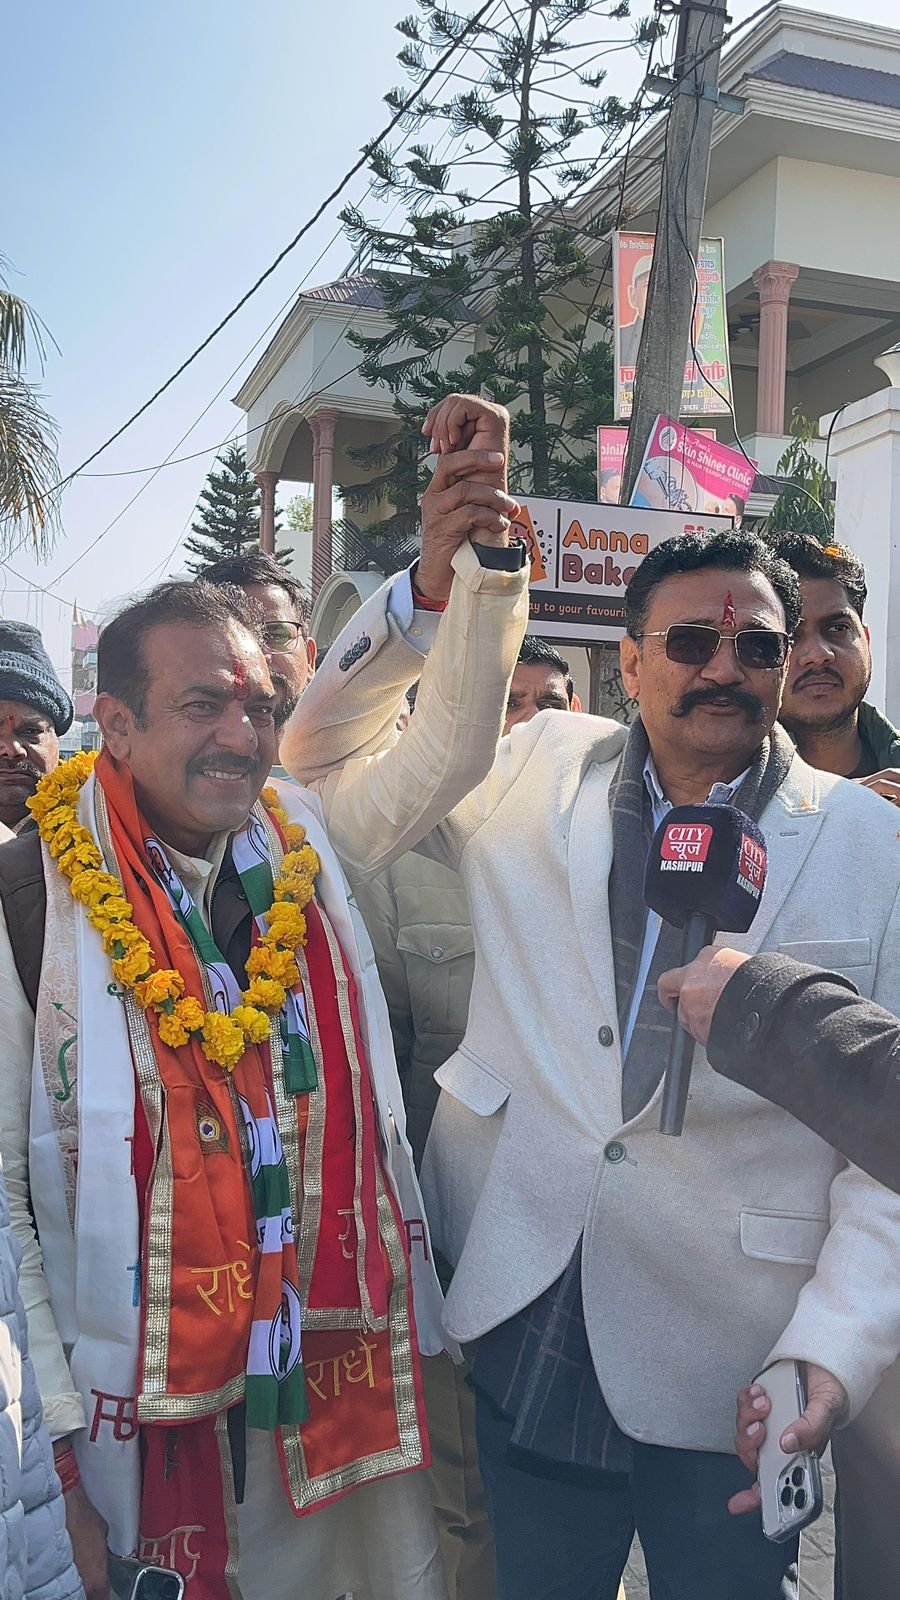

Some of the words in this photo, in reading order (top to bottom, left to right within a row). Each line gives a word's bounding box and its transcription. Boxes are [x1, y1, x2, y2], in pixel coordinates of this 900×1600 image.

[677, 441, 697, 459] Skin
[697, 450, 727, 474] Shines
[727, 465, 752, 486] Clinic
[563, 520, 649, 555] Anna
[544, 602, 555, 612] to
[559, 604, 583, 615] your
[586, 604, 627, 617] favouri
[668, 827, 708, 841] CITY
[669, 841, 702, 860] न्यूज
[744, 840, 765, 867] CITY
[660, 860, 704, 873] KASHIPUR
[744, 855, 762, 881] न्यूज
[306, 1336, 378, 1401] राधे
